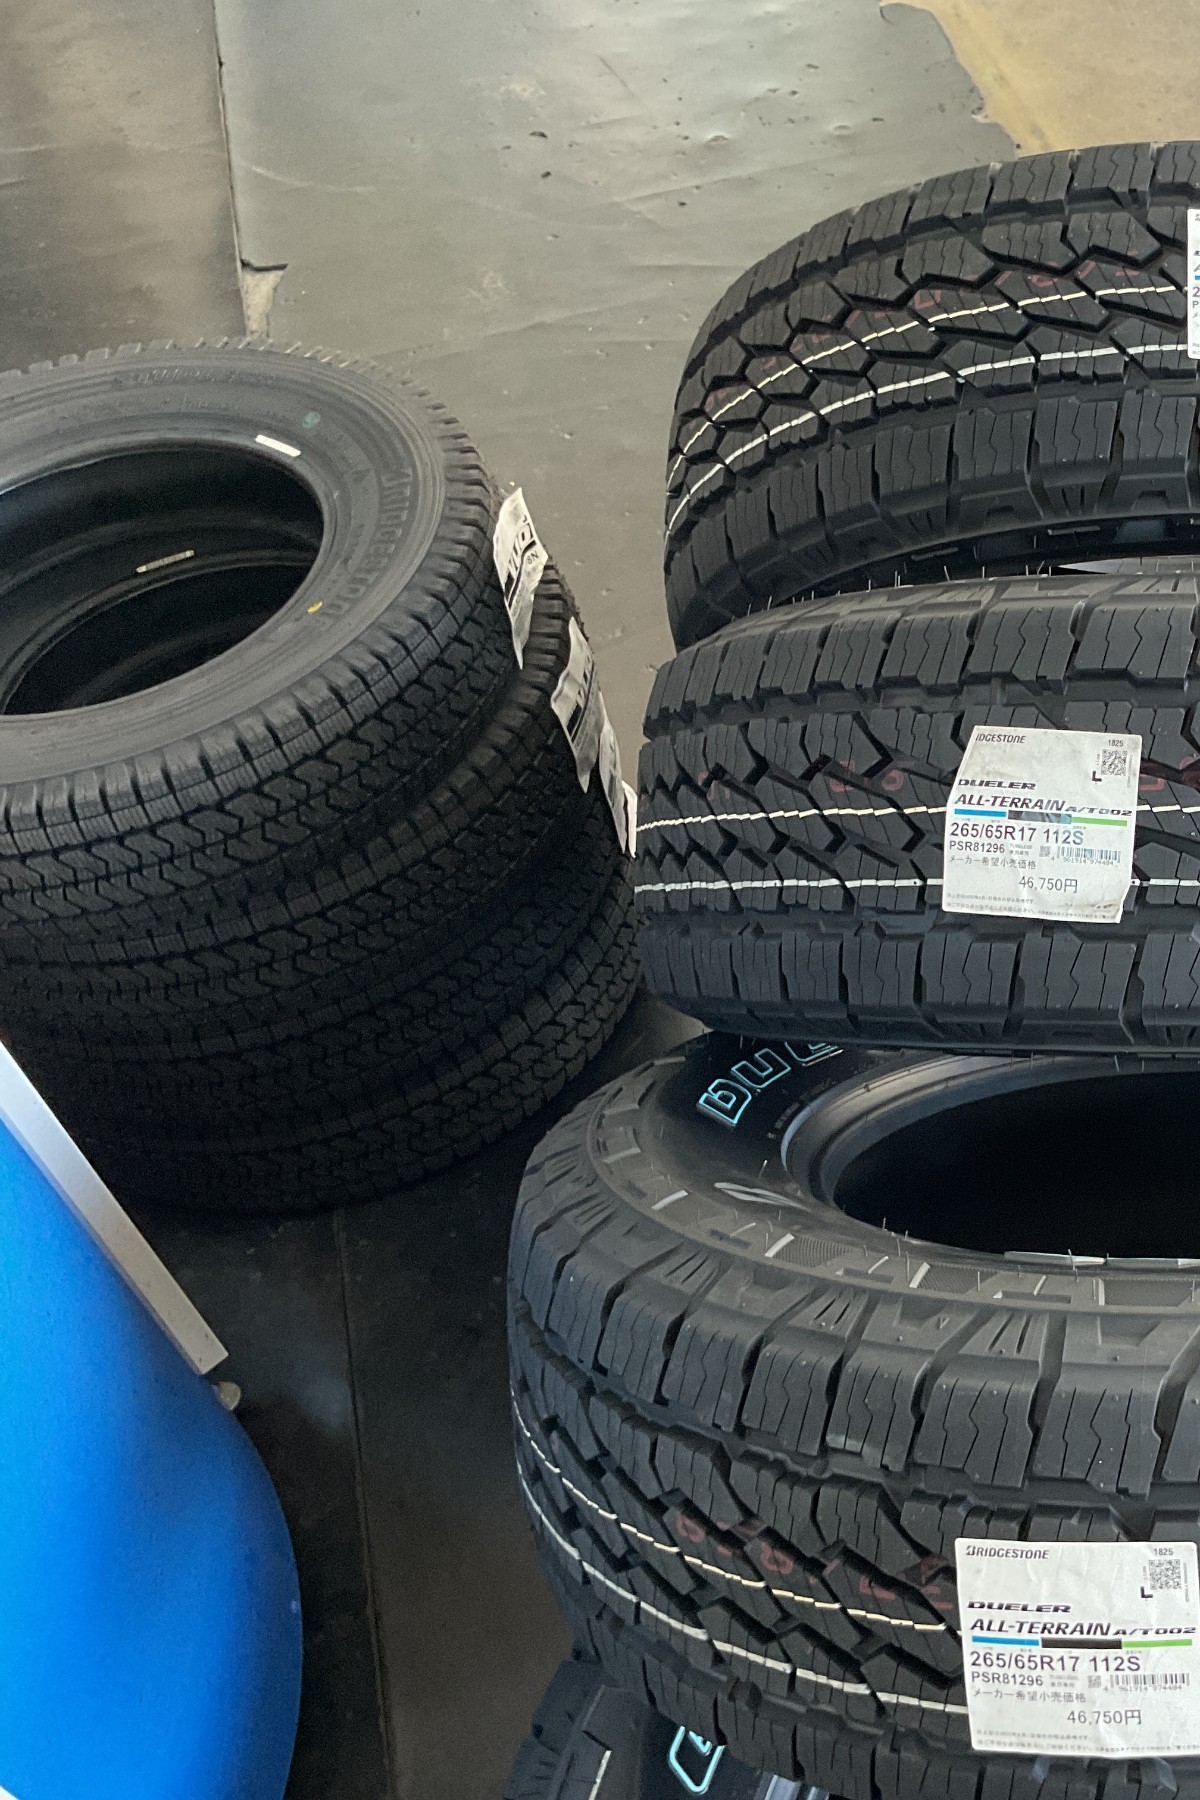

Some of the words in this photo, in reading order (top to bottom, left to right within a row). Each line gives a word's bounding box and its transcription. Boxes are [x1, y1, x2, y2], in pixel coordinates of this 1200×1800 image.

[957, 778, 1037, 791] DUELER
[954, 793, 1066, 811] ALL-TERRAIN
[950, 822, 1037, 842] 265/65R17
[1043, 830, 1084, 846] 112S
[949, 840, 1005, 853] PSR81296
[949, 854, 1037, 870] メーカー希望小売価格
[1018, 876, 1078, 894] 46,750円
[966, 1545, 1049, 1560] BRIDGESTONE
[1154, 1548, 1174, 1556] 1825
[967, 1601, 1072, 1613] DUELER
[970, 1618, 1111, 1636] ALL-TERRAIN
[970, 1651, 1080, 1672] 265/65R17
[1089, 1656, 1141, 1672] 112S
[971, 1672, 1044, 1686] PSR81296
[973, 1688, 1086, 1703] メーカー希望小売価格
[1067, 1710, 1142, 1726] 46,750円
